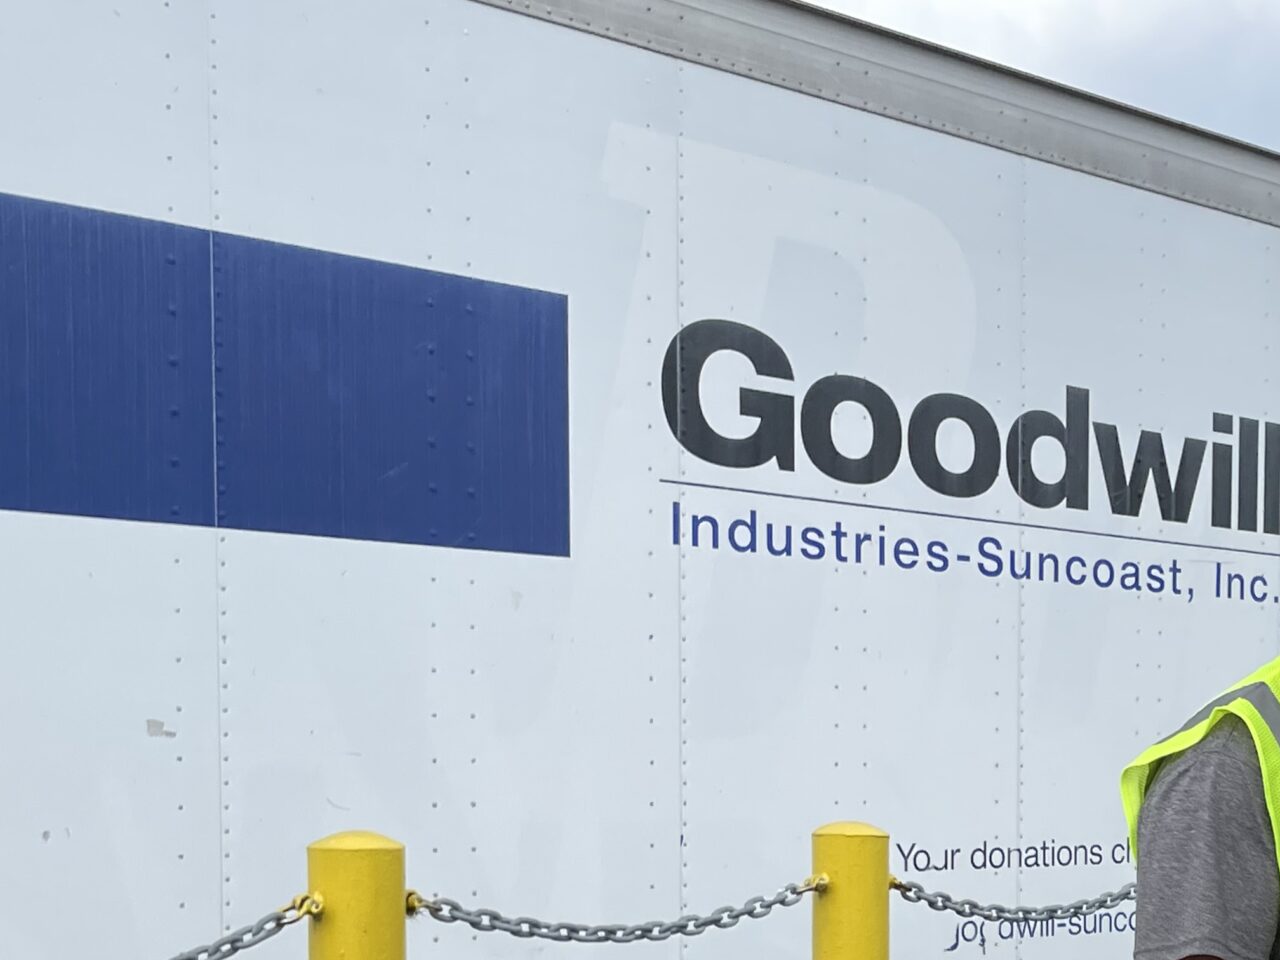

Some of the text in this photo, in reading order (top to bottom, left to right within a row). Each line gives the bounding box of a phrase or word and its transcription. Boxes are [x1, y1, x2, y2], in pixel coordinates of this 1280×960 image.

[670, 502, 1280, 604] Industries-Suncoast, Inc.
[896, 843, 961, 872] Your
[970, 838, 1103, 871] donations
